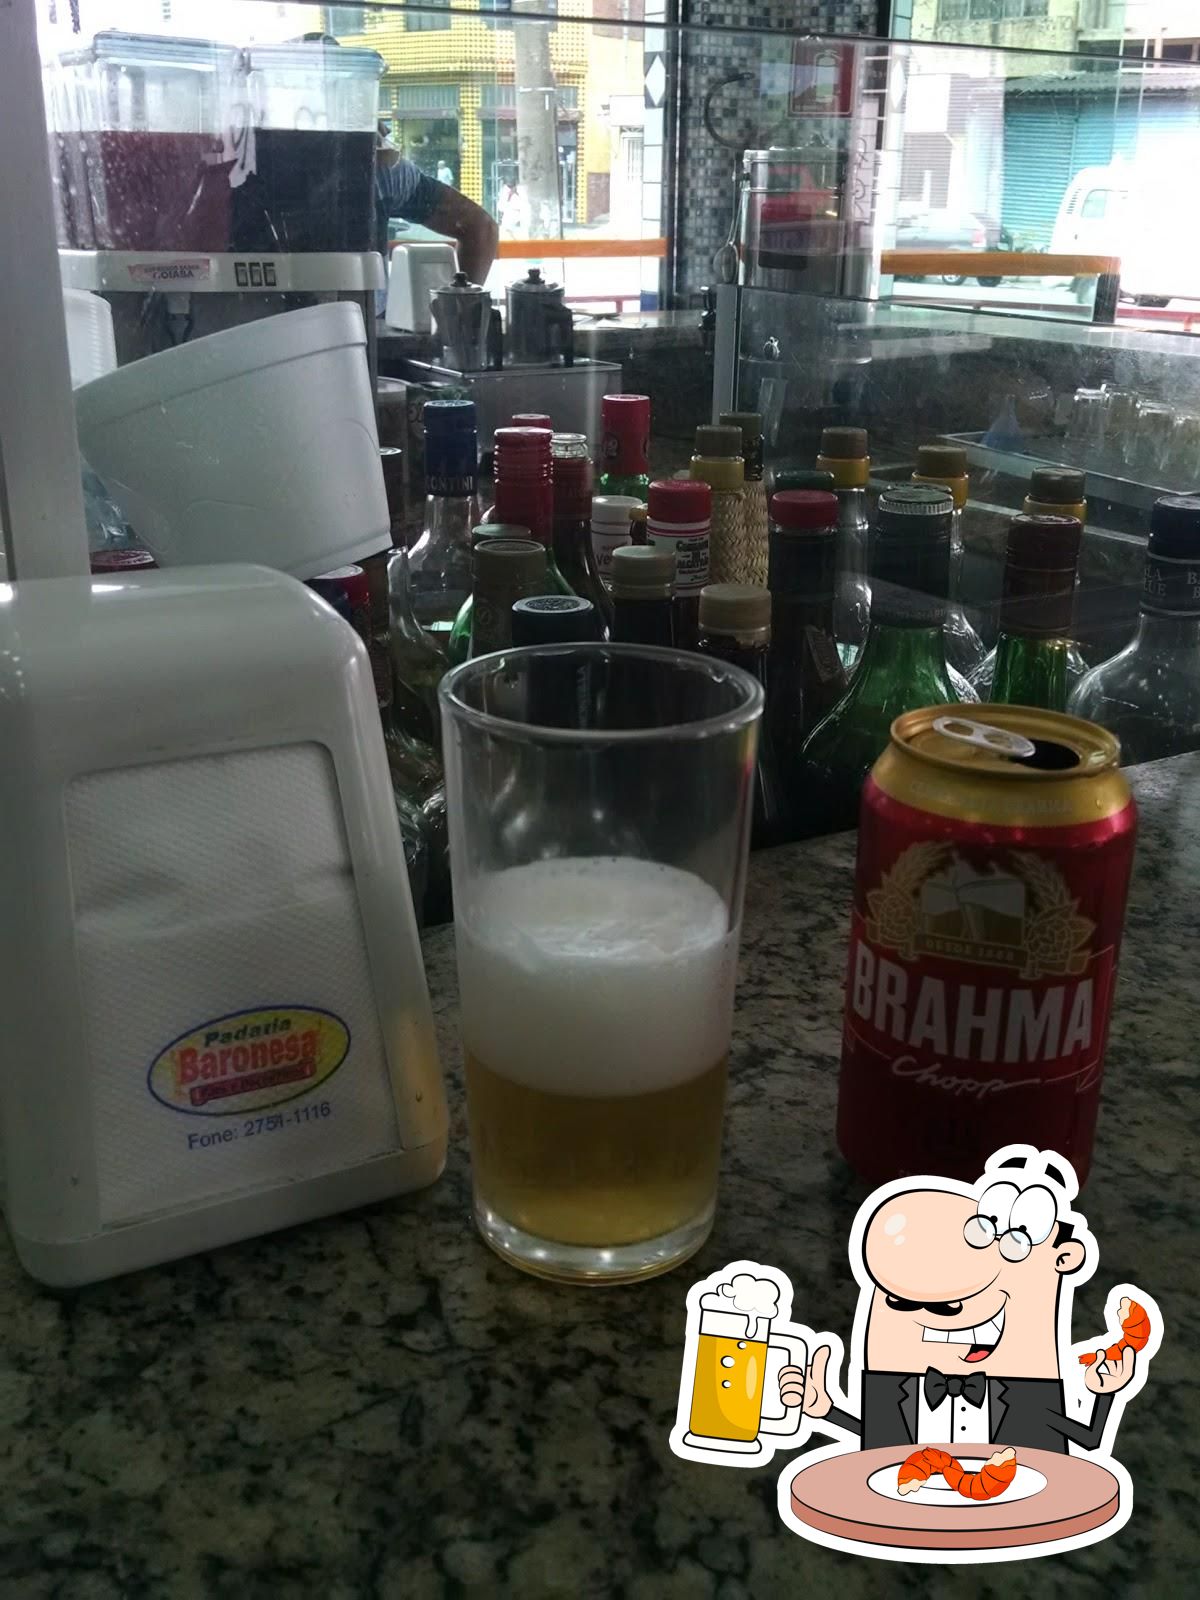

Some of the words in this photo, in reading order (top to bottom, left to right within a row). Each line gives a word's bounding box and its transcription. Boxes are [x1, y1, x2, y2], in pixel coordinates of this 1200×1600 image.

[852, 938, 1094, 1063] BRAHMA
[205, 1017, 292, 1047] Padaria
[178, 1029, 318, 1085] Baronesa
[892, 1055, 1041, 1100] Chopp
[187, 1130, 238, 1150] Fone:
